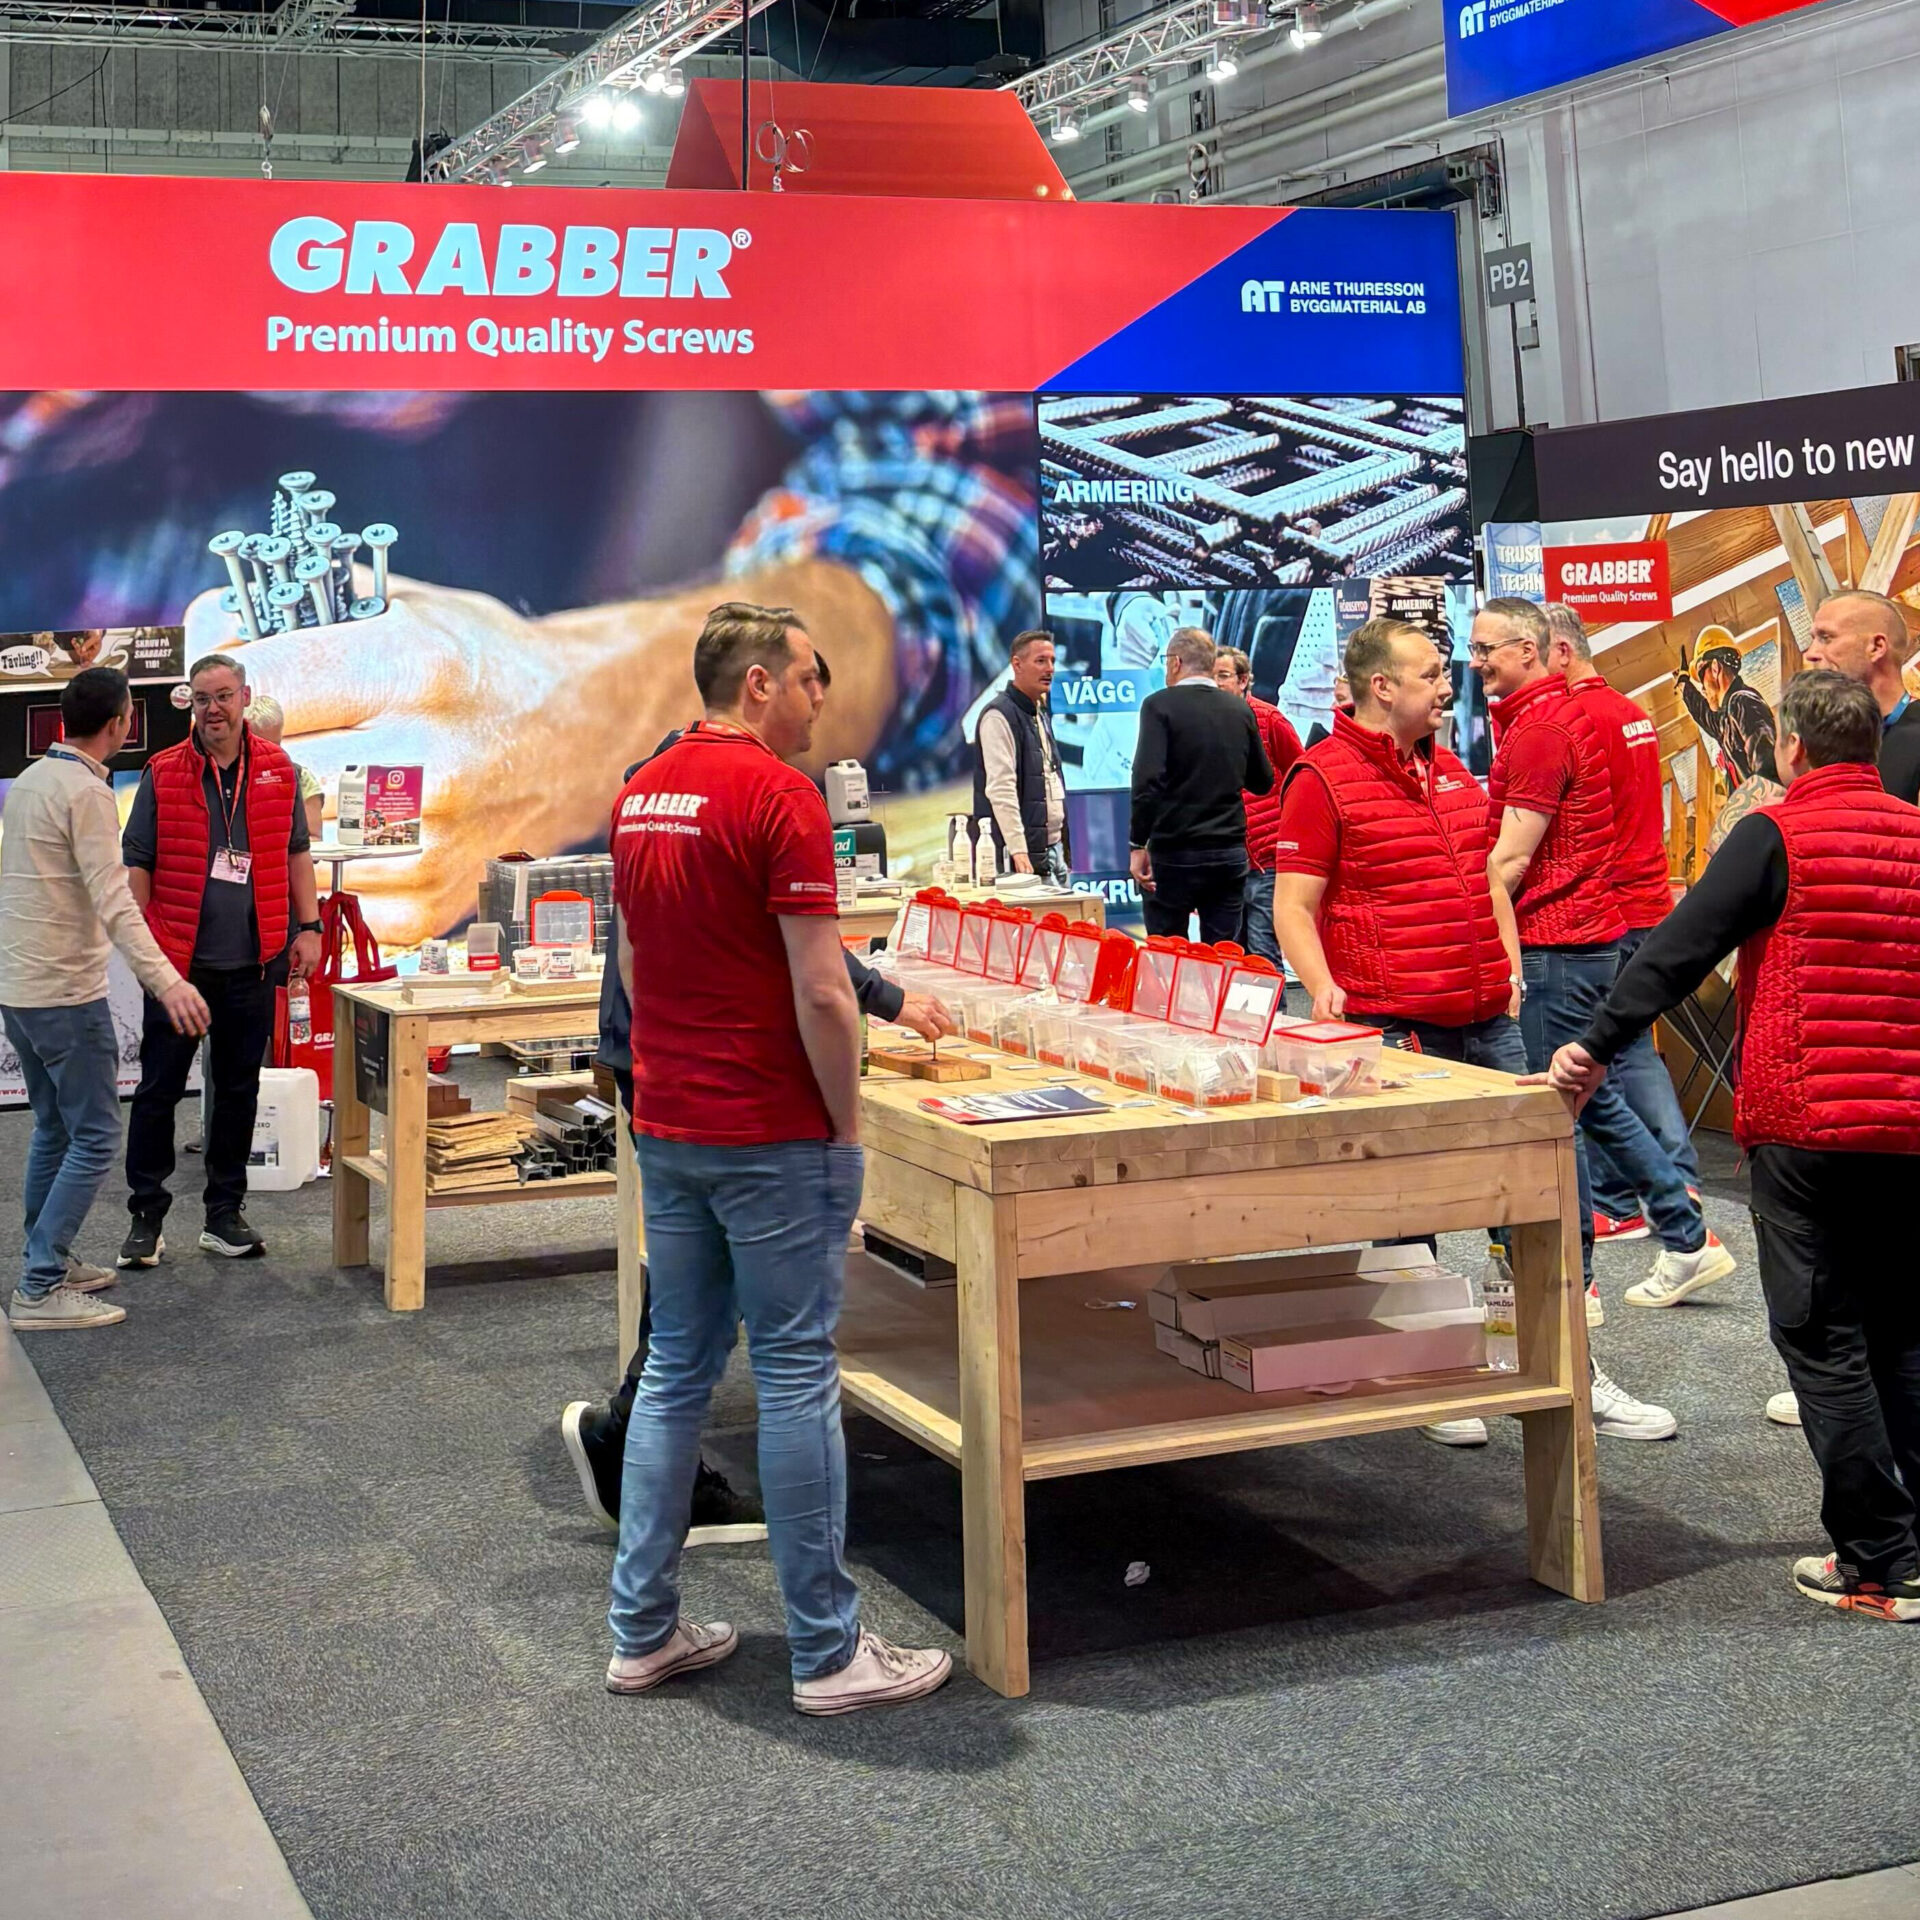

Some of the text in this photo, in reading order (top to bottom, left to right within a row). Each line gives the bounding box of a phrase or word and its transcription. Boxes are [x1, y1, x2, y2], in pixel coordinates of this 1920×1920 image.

[1489, 0, 1515, 11] AR
[1490, 0, 1565, 28] BYGGMATERI
[1490, 258, 1530, 293] PB2
[1241, 279, 1285, 312] AT
[1289, 281, 1425, 297] ARNE THURESSON
[1290, 299, 1427, 315] BYGGMATERIAL AB
[267, 316, 755, 363] Premium Quality Screws
[1658, 434, 1915, 496] Say hello to new
[1053, 480, 1195, 503] ARMERING
[1392, 599, 1434, 611] ARMERING
[1562, 589, 1658, 605] Premium Quality Screws
[1, 650, 43, 669] Tävling!!
[1062, 676, 1136, 705] VÄGG
